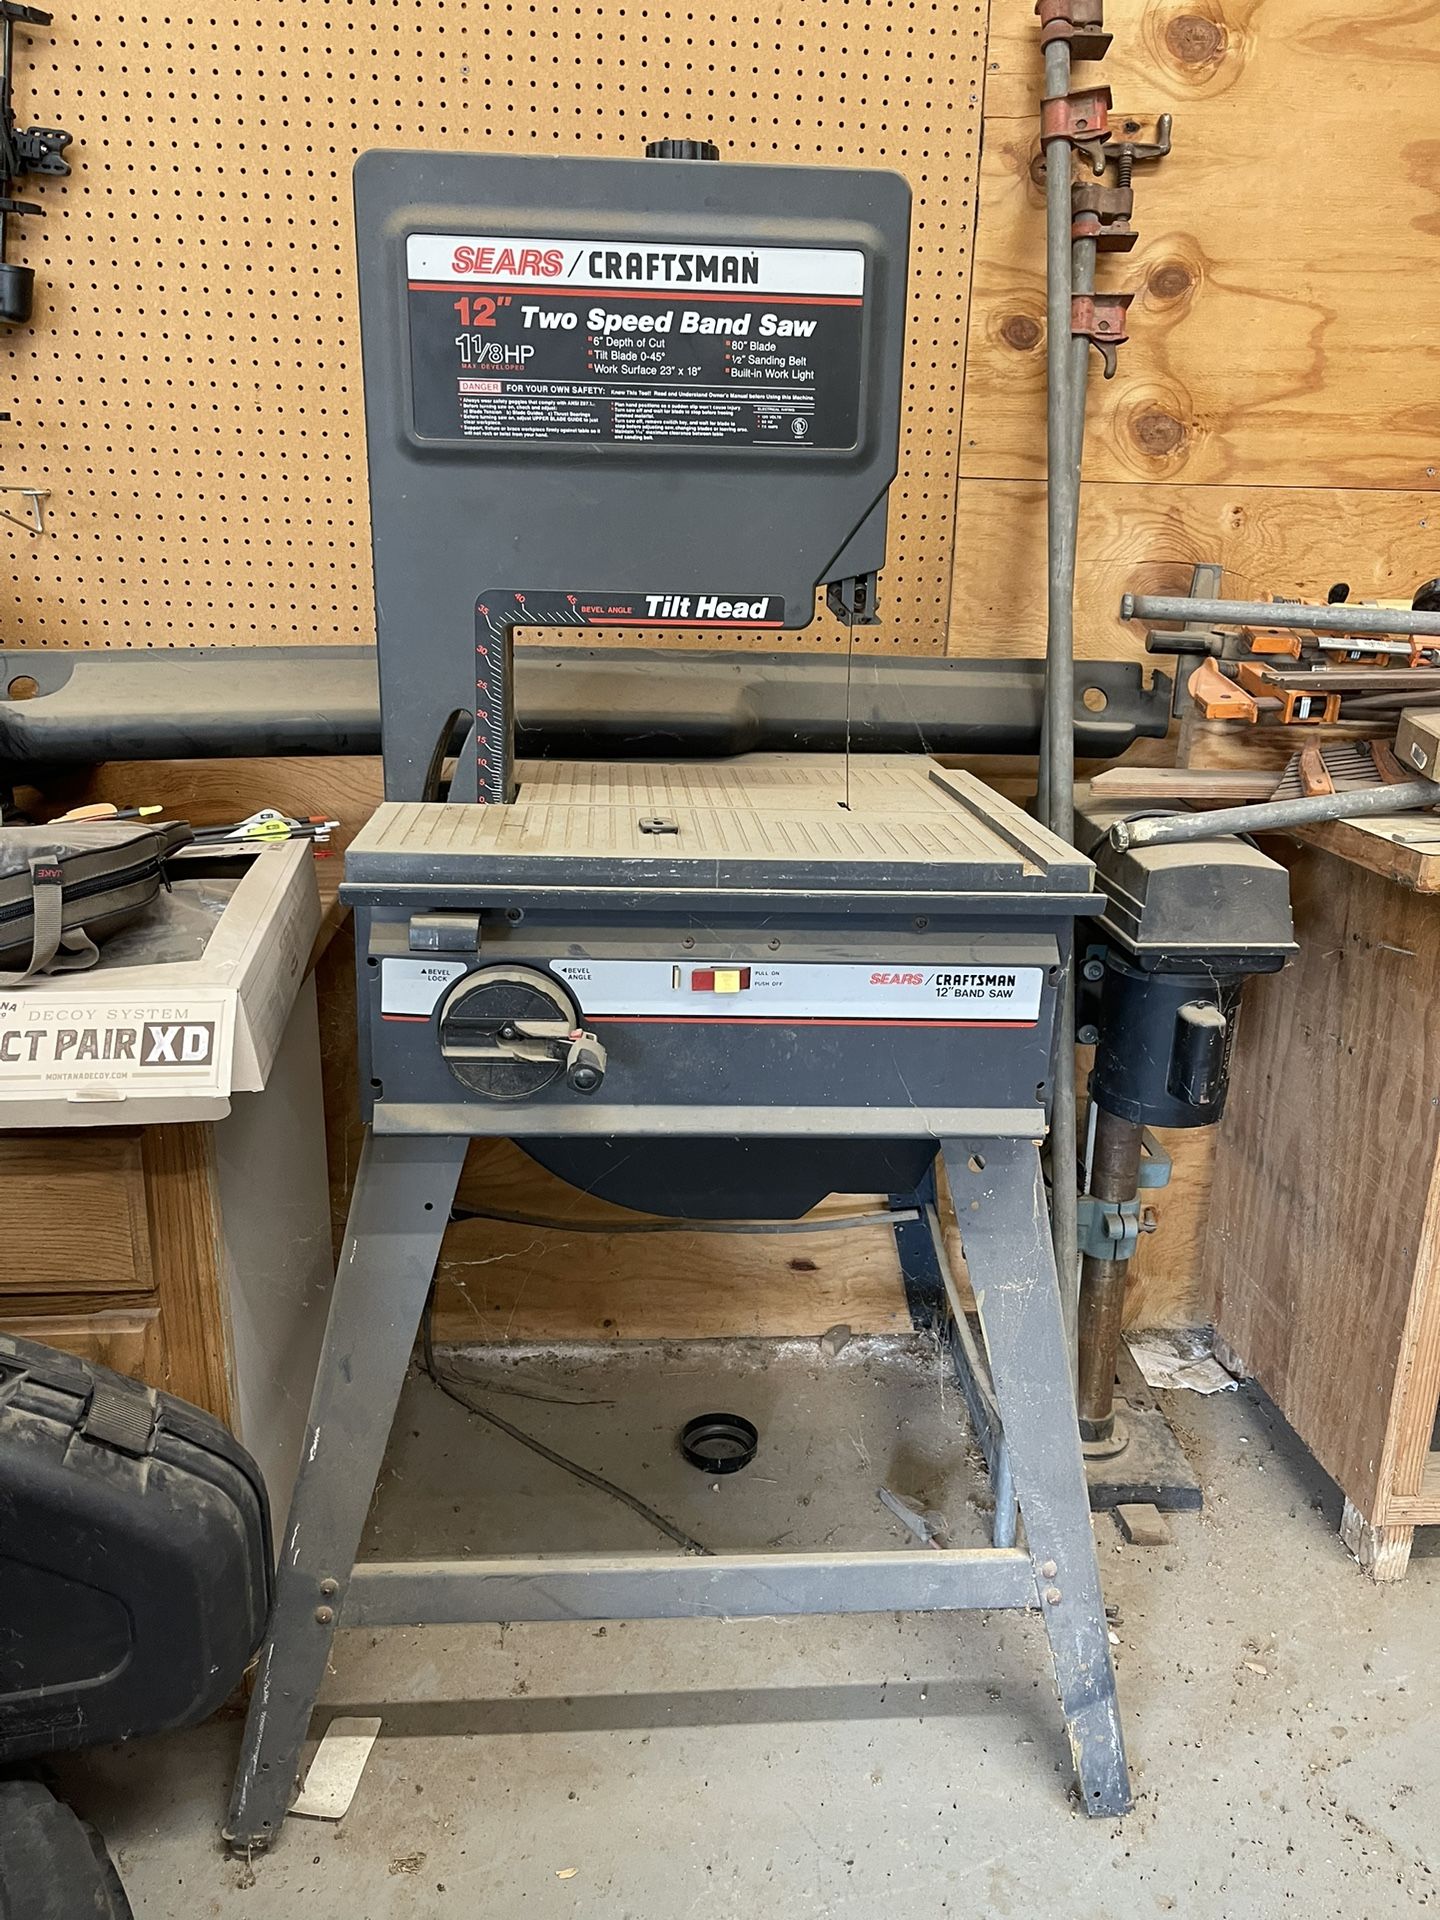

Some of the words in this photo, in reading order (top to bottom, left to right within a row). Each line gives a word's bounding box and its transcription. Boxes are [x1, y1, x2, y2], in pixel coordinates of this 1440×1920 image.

[452, 246, 564, 277] SEARS
[589, 252, 759, 285] CRAFTSMAN
[521, 306, 577, 330] Two
[587, 308, 674, 335] Speed
[680, 311, 751, 335] Band
[759, 314, 817, 338] Saw
[606, 337, 633, 348] Depth
[637, 338, 645, 347] of
[649, 338, 665, 348] Cut
[750, 341, 776, 351] Blade
[594, 350, 608, 360] Tilt
[611, 351, 637, 361] Blade
[748, 355, 785, 368] Sanding
[789, 356, 806, 366] Belt
[594, 364, 618, 374] Work
[621, 364, 657, 375] Surface
[678, 368, 684, 376] x
[731, 368, 762, 378] Built-in
[765, 369, 788, 379] Work
[792, 370, 814, 381] Light
[462, 382, 499, 391] DANGER
[507, 384, 523, 393] FOR
[526, 384, 548, 393] YOUR
[551, 385, 570, 394] OWN
[572, 386, 605, 395] SAFETY:
[515, 593, 526, 604] 40
[566, 594, 577, 605] 45
[478, 604, 490, 615] 35
[581, 605, 605, 614] BEVEL
[608, 606, 633, 614] ANGLE
[646, 595, 691, 618] Tilt
[696, 596, 769, 619] Head
[477, 644, 488, 655] 30
[477, 679, 488, 689] 25
[477, 708, 488, 718] 20
[477, 736, 487, 744] 15
[477, 758, 487, 767] 10
[479, 777, 486, 785] 5
[428, 968, 451, 976] BEVEL
[869, 973, 924, 986] SEARS
[936, 974, 1016, 987] CRAFTSMAN
[955, 989, 984, 998] BAND
[989, 989, 1014, 998] SAW
[29, 1009, 97, 1022] DECOY
[106, 1008, 190, 1021] SYSTEM
[54, 1029, 138, 1061] PAIR
[144, 1025, 211, 1062] XD
[45, 1071, 128, 1081] MONTANADECOY.COM
